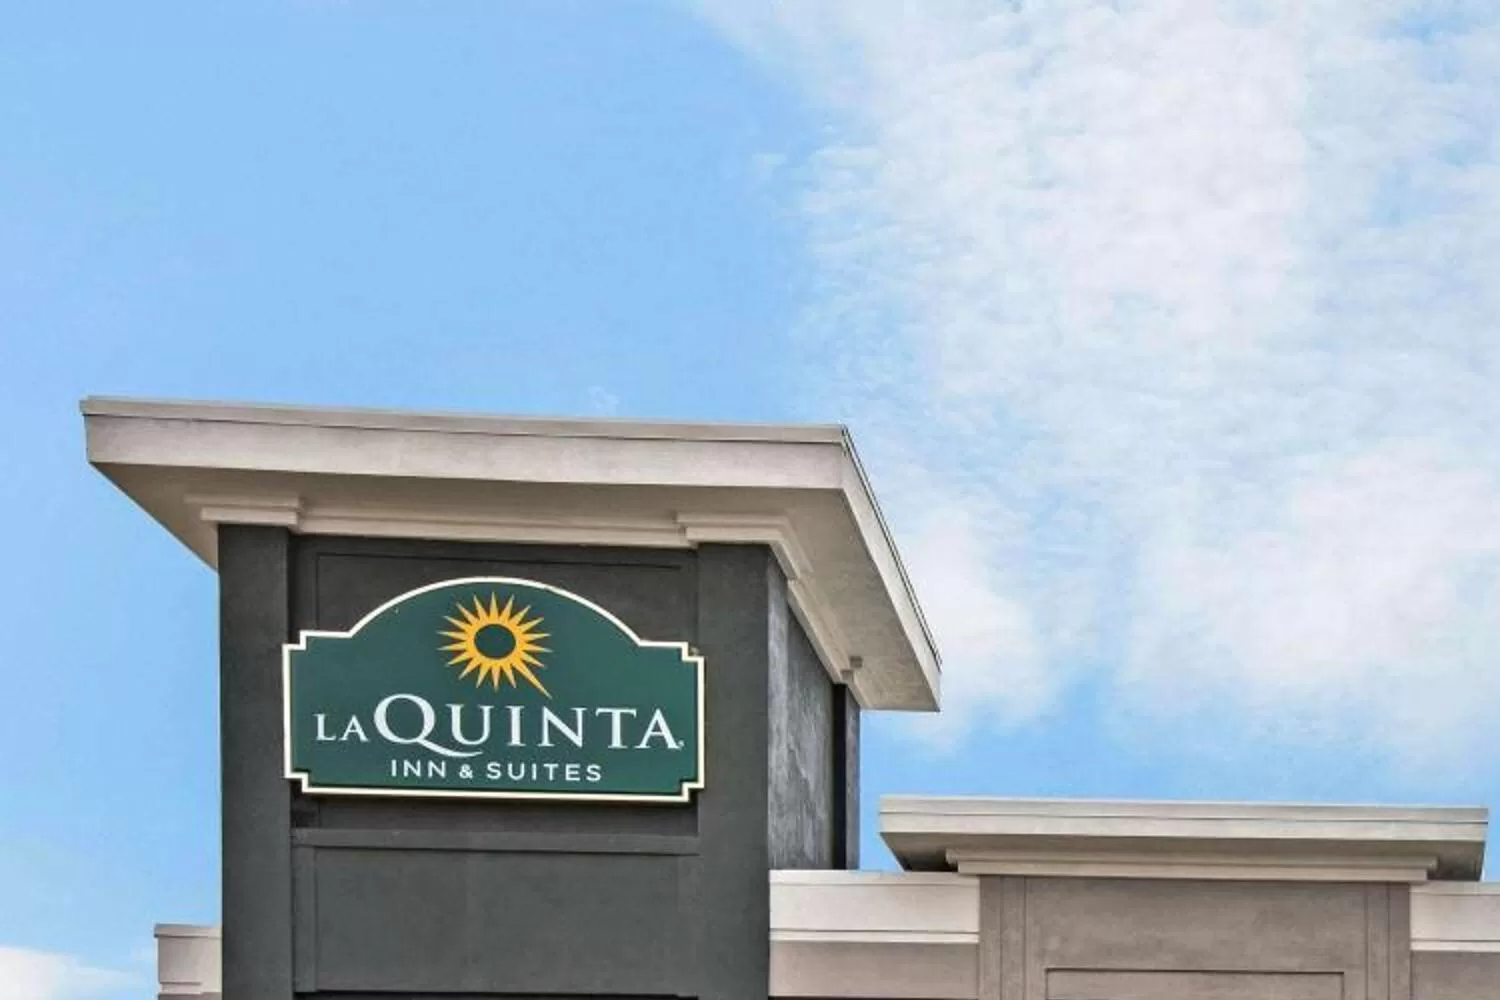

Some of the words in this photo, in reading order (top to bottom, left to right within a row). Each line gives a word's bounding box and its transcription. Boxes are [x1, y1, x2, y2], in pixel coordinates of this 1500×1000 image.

[314, 713, 368, 742] LA
[373, 693, 682, 757] QUINTA
[391, 759, 446, 778] INN
[459, 763, 473, 779] &
[486, 761, 602, 781] SUITES
